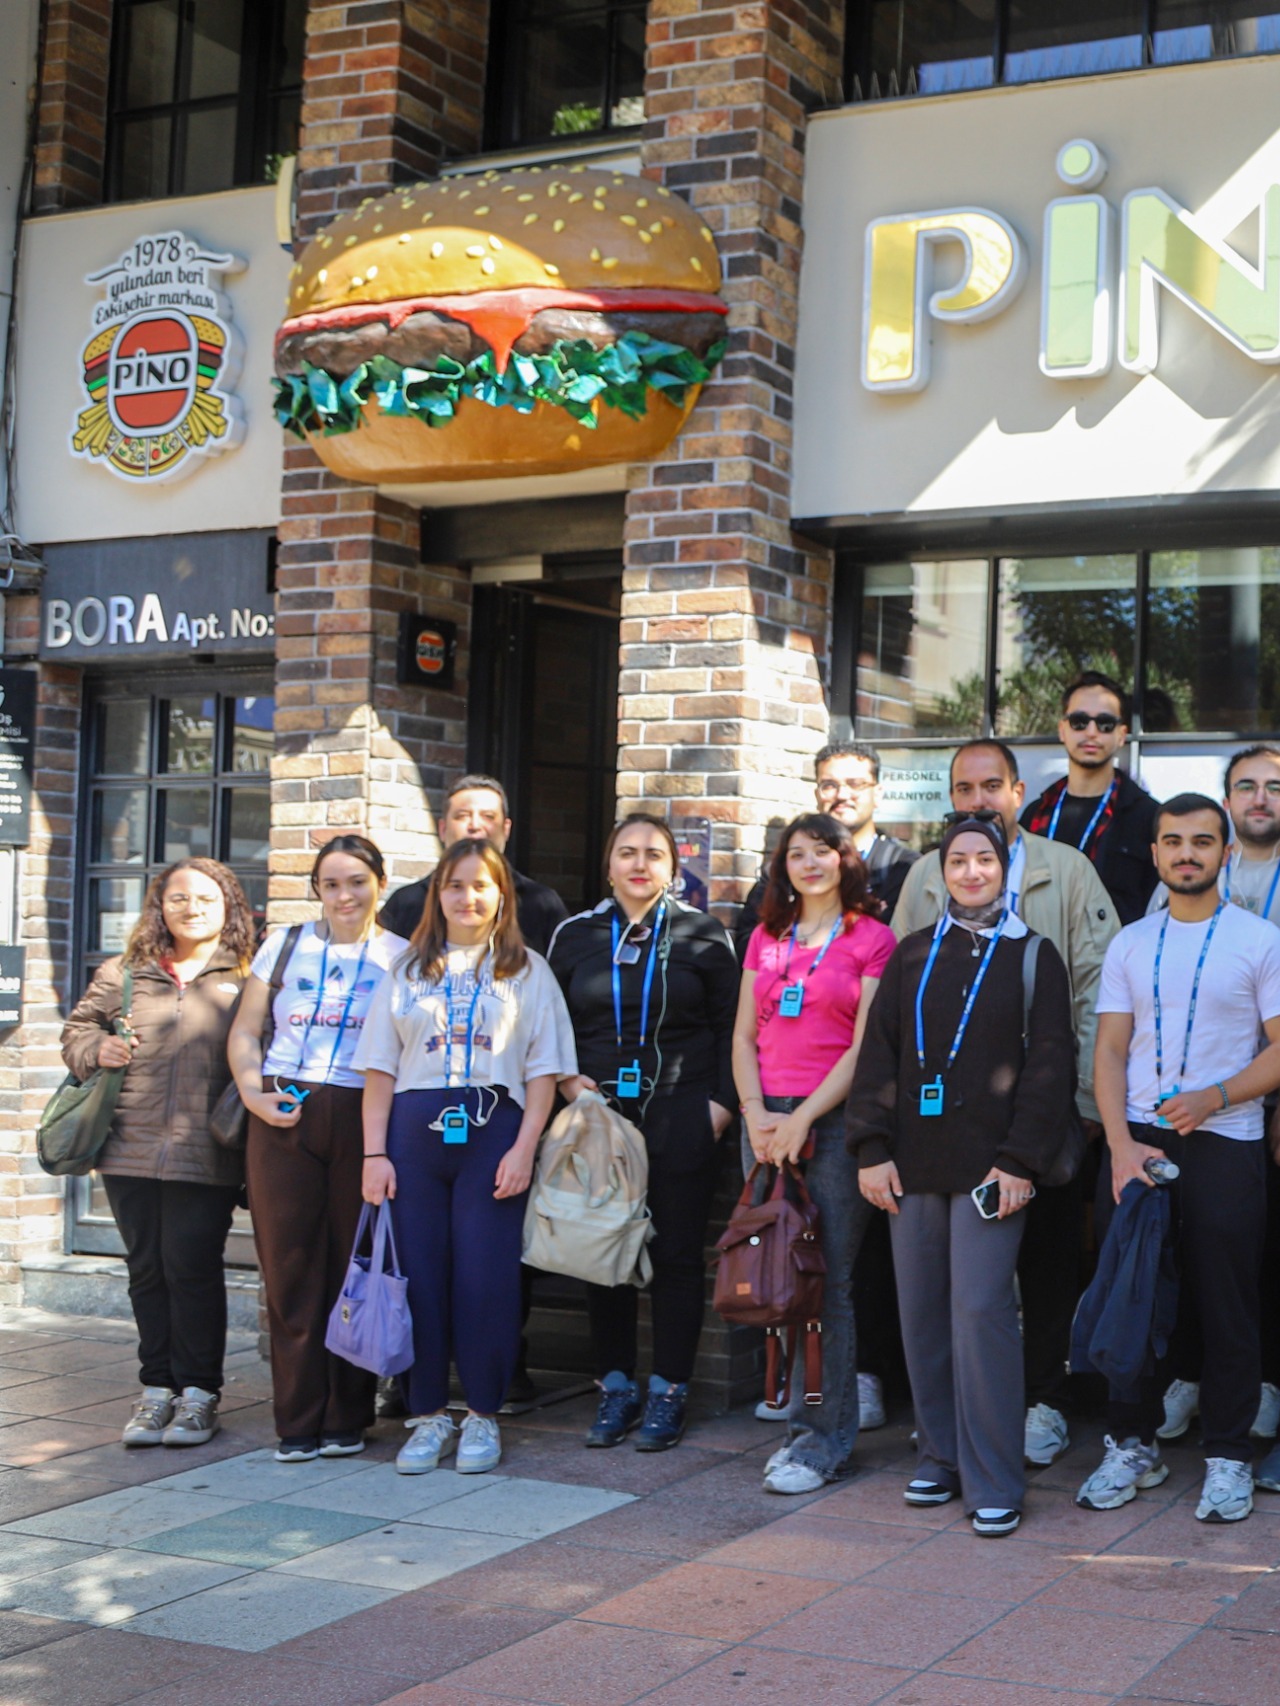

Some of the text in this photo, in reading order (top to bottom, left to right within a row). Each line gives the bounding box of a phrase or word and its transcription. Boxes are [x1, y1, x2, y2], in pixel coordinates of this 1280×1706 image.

[135, 236, 181, 267] 1978
[111, 266, 204, 301] yılından beri
[96, 289, 216, 325] Eskişehir markası
[45, 593, 275, 648] BORA Apt. No:
[883, 772, 942, 781] PERSONEL
[882, 791, 942, 801] ARANIYOR
